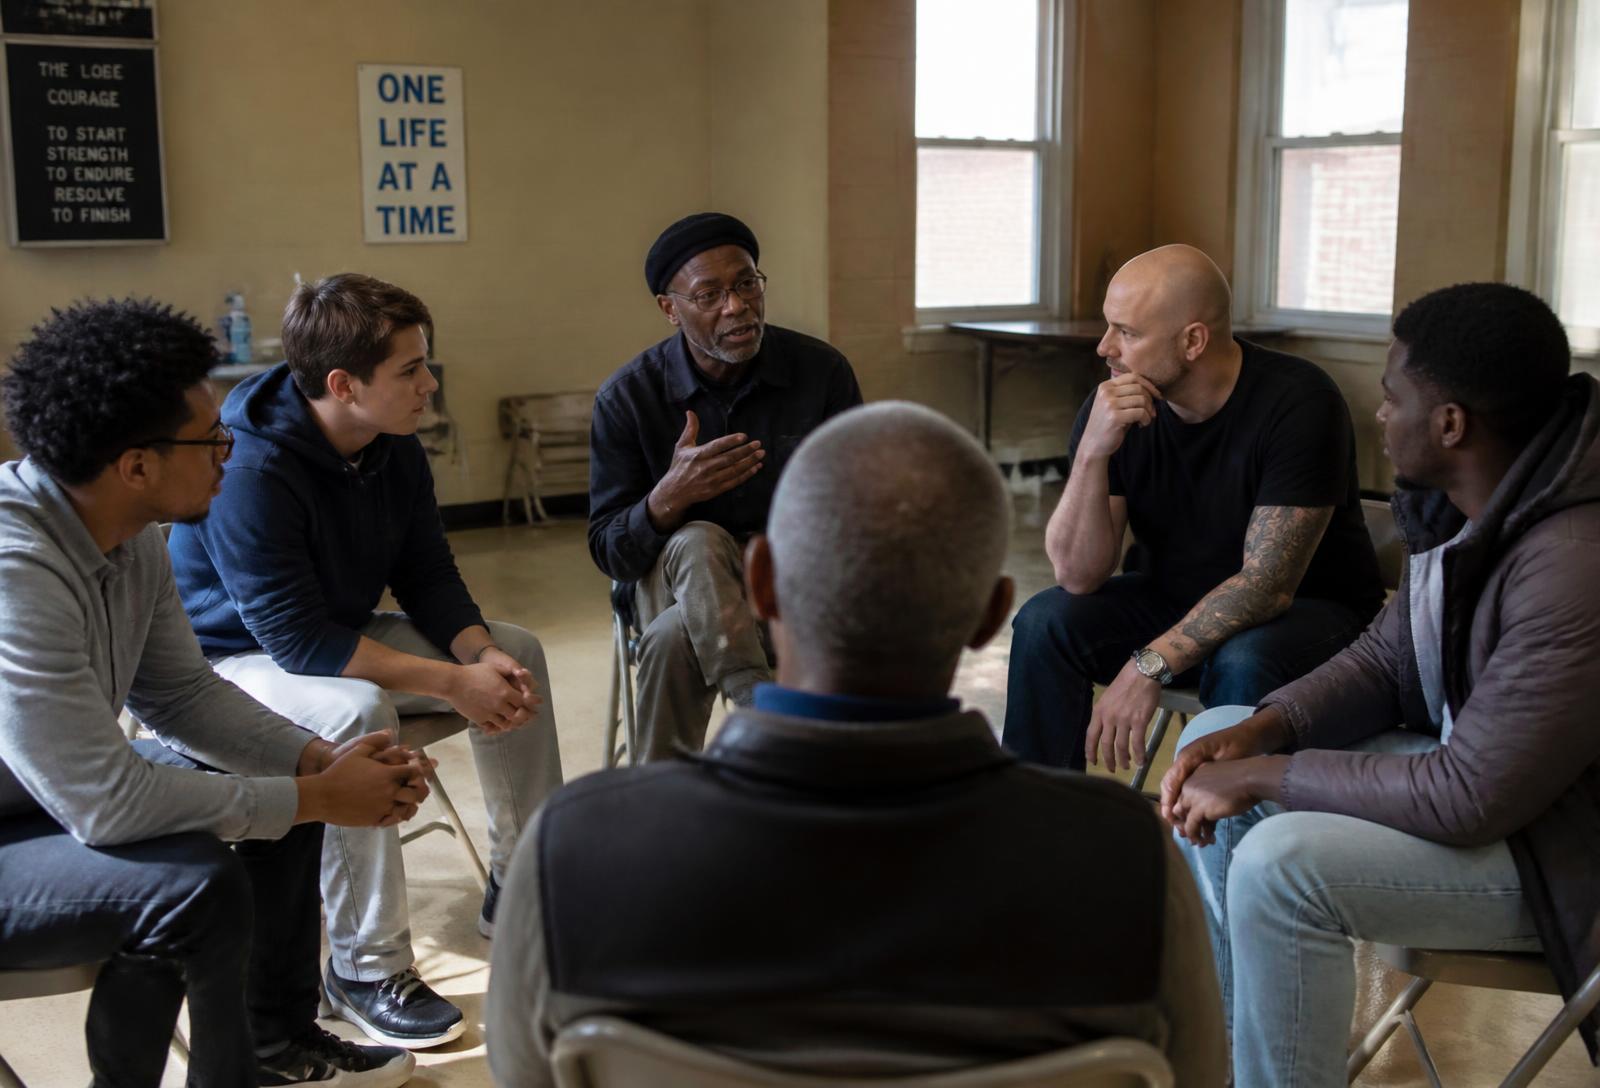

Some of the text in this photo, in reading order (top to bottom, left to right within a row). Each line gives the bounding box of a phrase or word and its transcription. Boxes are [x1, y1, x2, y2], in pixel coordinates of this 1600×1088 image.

[38, 61, 69, 78] THE
[378, 73, 445, 104] ONE
[47, 88, 120, 107] COURAGE
[47, 126, 126, 142] TO START
[379, 118, 447, 147] LIFE
[47, 146, 128, 162] STRENGTH
[46, 166, 135, 182] TO ENDURE
[378, 162, 452, 191] AT A
[54, 187, 125, 203] RESOLVE
[52, 207, 131, 223] TO FINISH
[376, 205, 455, 235] TIME
